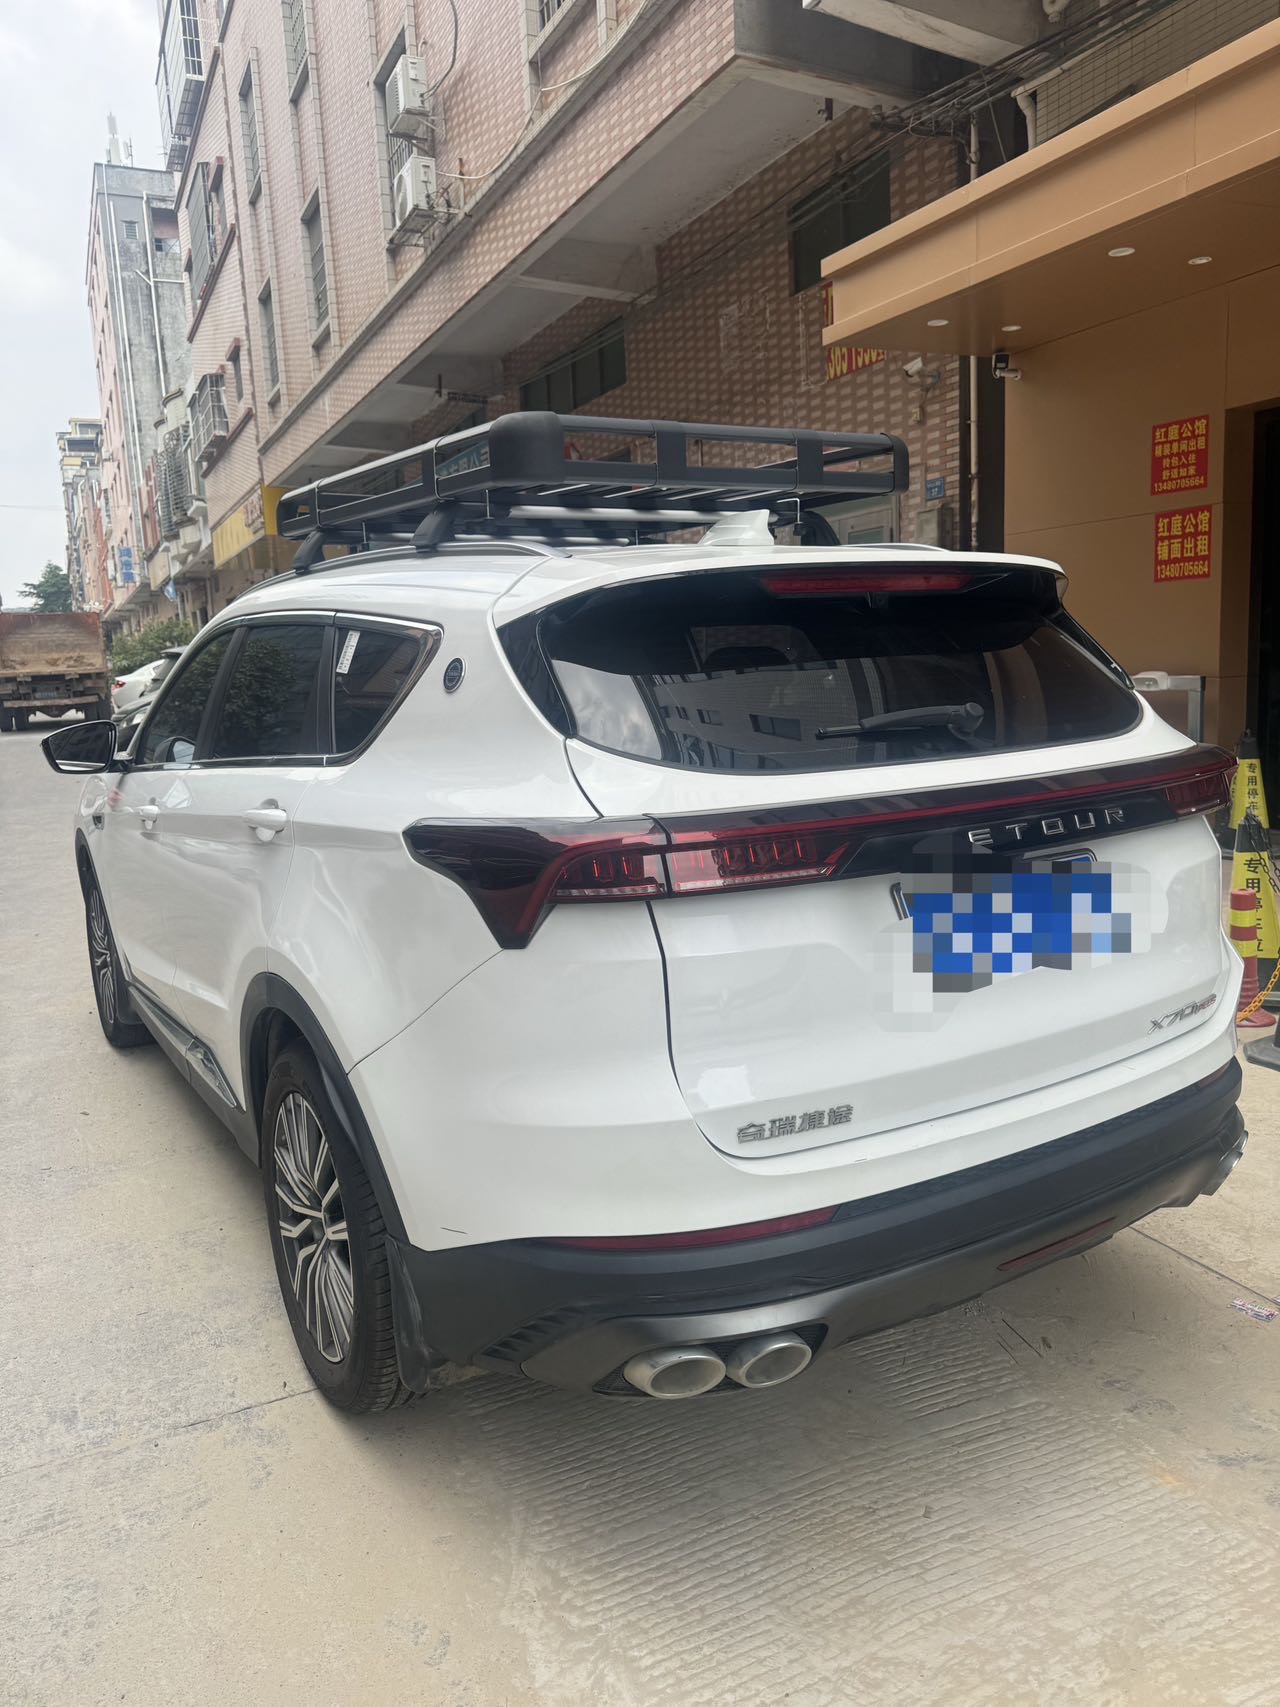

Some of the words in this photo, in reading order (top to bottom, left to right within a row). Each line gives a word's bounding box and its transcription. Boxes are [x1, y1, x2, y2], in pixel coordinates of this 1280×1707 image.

[1154, 418, 1207, 443] 红庭公馆
[1154, 436, 1206, 457] 精装单间出租
[1154, 476, 1204, 492] 13480705664
[1162, 465, 1197, 480] 舒适如家
[1157, 510, 1210, 537] 红庭公馆
[1157, 535, 1209, 560] 铺面出租
[1157, 560, 1209, 579] 13480705664
[967, 807, 1126, 846] ETOUR
[1146, 1000, 1200, 1035] X70
[736, 1103, 854, 1144] 奇瑞捷途
